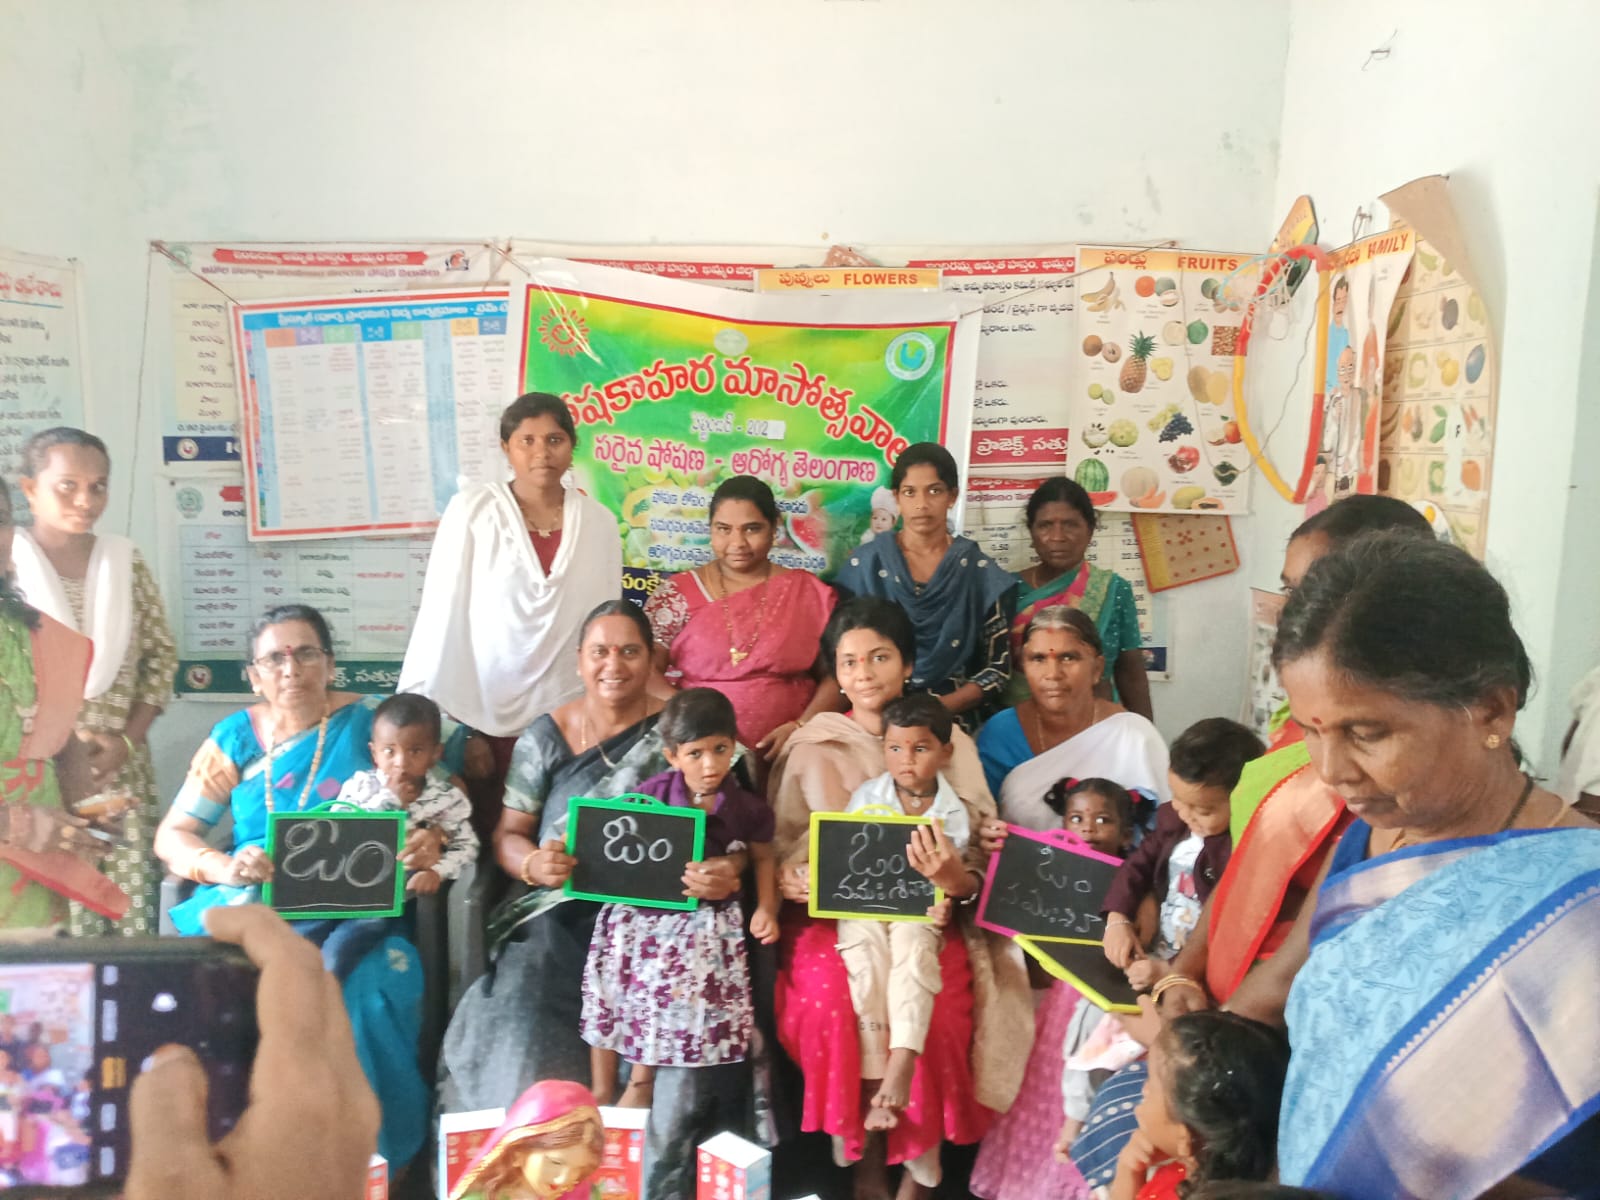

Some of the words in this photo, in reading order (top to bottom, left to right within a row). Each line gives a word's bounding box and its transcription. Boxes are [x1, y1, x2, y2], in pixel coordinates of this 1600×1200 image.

[844, 273, 918, 285] FLOWERS
[1177, 256, 1238, 271] FRUITS
[595, 434, 643, 472] సరైన
[793, 451, 876, 482] తెలంగాణ
[602, 815, 673, 866] ఓం
